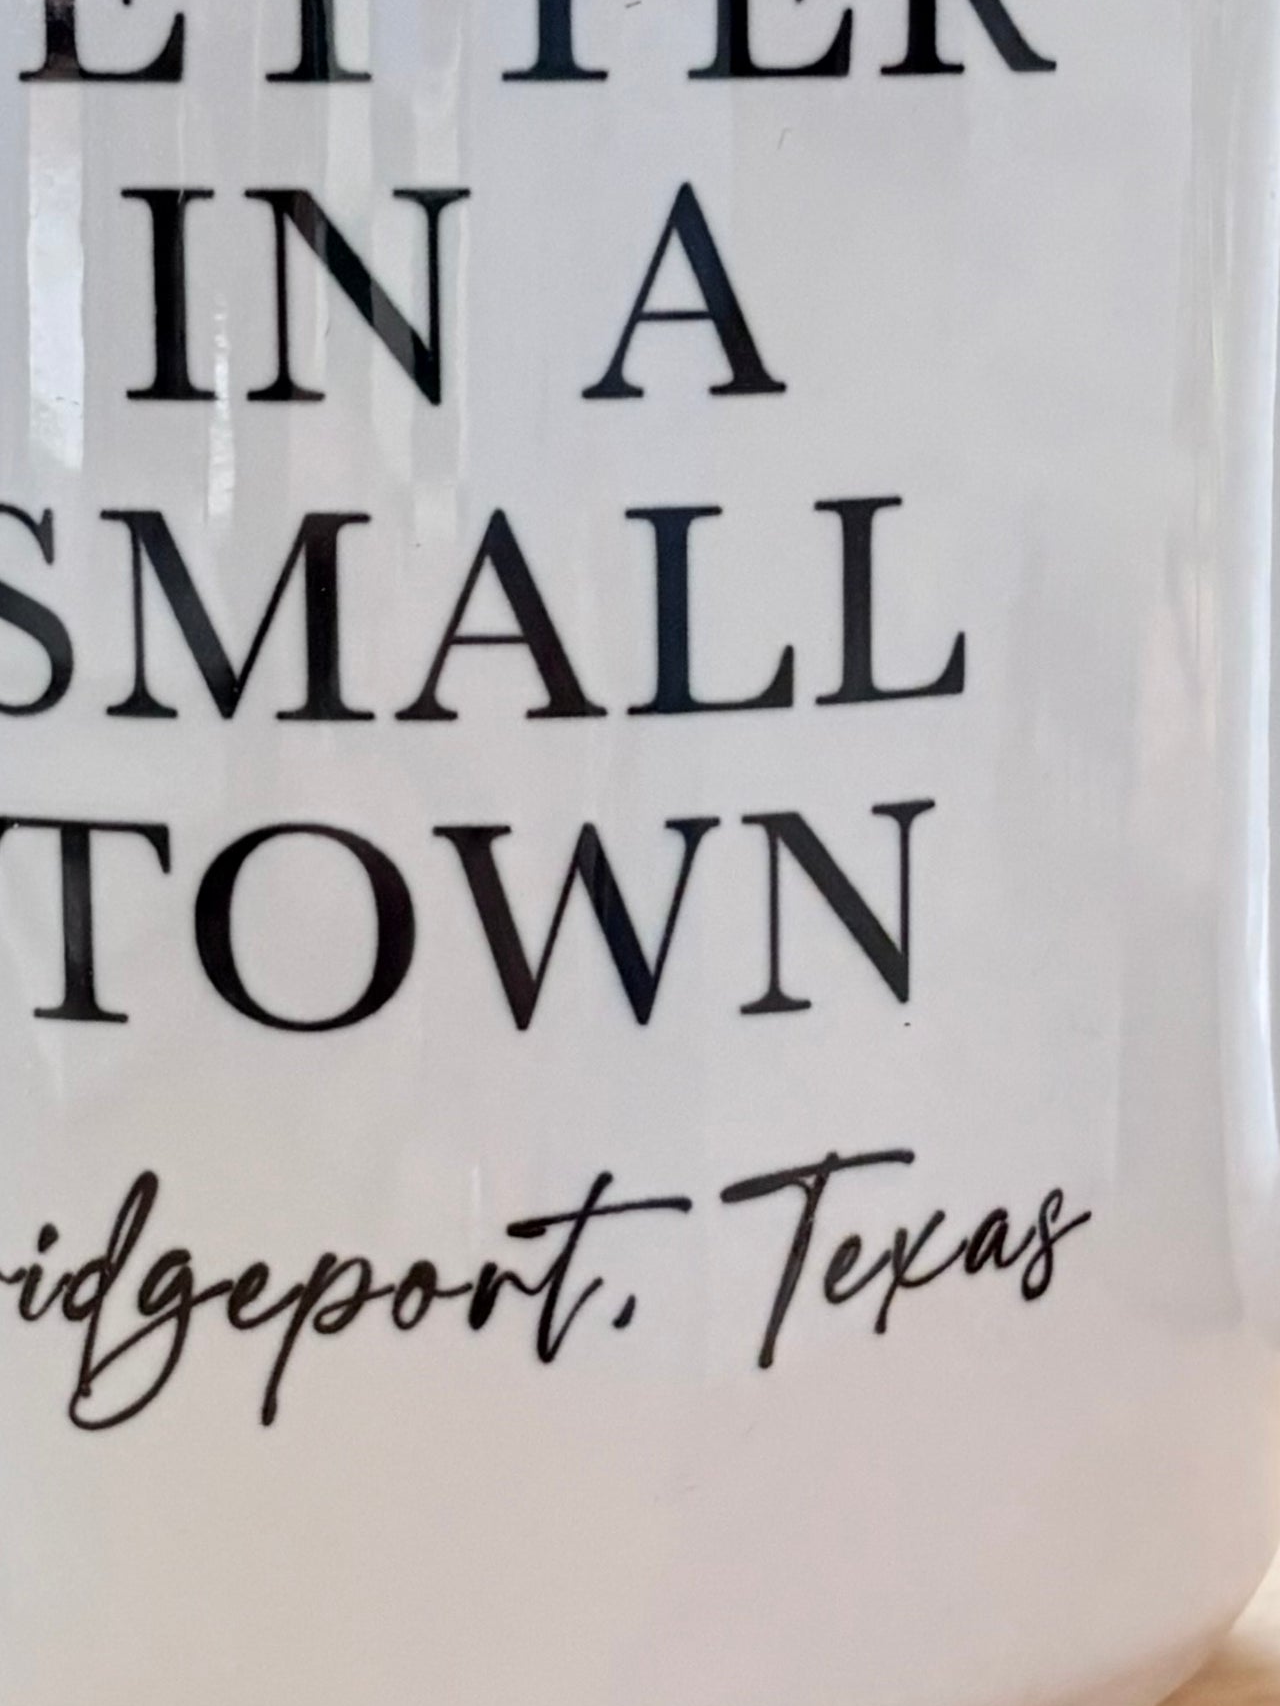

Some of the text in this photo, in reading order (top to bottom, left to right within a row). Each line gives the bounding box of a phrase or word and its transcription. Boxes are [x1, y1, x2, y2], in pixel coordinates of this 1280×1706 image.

[118, 180, 789, 408] IN A
[718, 1148, 1093, 1371] Texas
